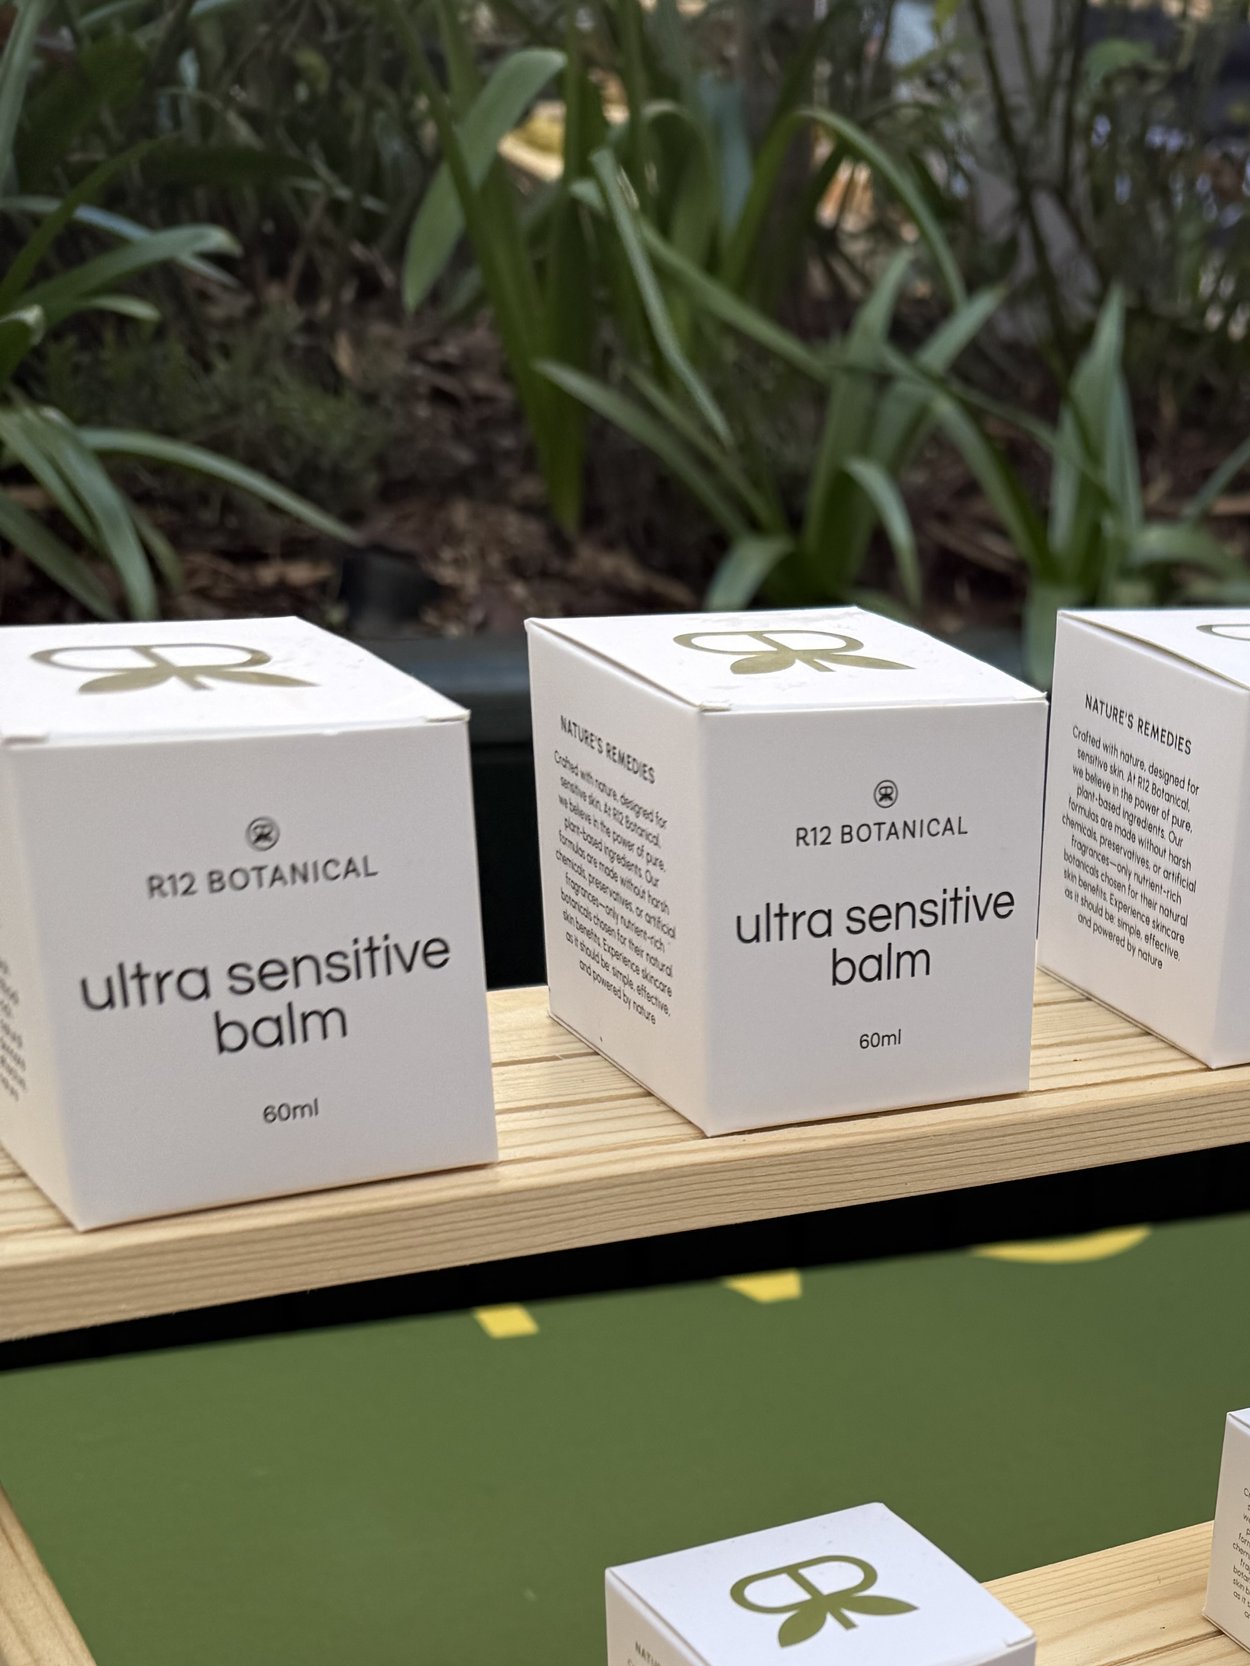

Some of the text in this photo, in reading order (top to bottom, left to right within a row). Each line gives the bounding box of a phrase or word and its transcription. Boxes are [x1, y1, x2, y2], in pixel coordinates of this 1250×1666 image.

[560, 715, 655, 784] NATURE'S REMEDIES
[1085, 693, 1191, 755] NATURE'S REMEDIES
[1073, 725, 1199, 795] Crafted with nature, designed for
[1078, 749, 1108, 772] sensitive
[1126, 771, 1135, 785] At
[1137, 775, 1150, 792] R12
[1073, 765, 1083, 778] we
[1085, 769, 1111, 792] believe
[1112, 783, 1119, 797] in
[1120, 787, 1133, 803] the
[1134, 796, 1159, 816] power
[1161, 808, 1170, 821] of
[1076, 785, 1183, 847] plant-based ingredients. Our
[795, 815, 969, 848] R12 BOTANICAL
[145, 854, 379, 899] R12 BOTANICAL
[735, 885, 1015, 944] ultra sensitive
[79, 933, 451, 1011] ultra sensitive
[831, 943, 931, 987] balm
[213, 1002, 348, 1055] balm
[858, 1027, 902, 1050] 60ml
[261, 1096, 319, 1125] 60ml
